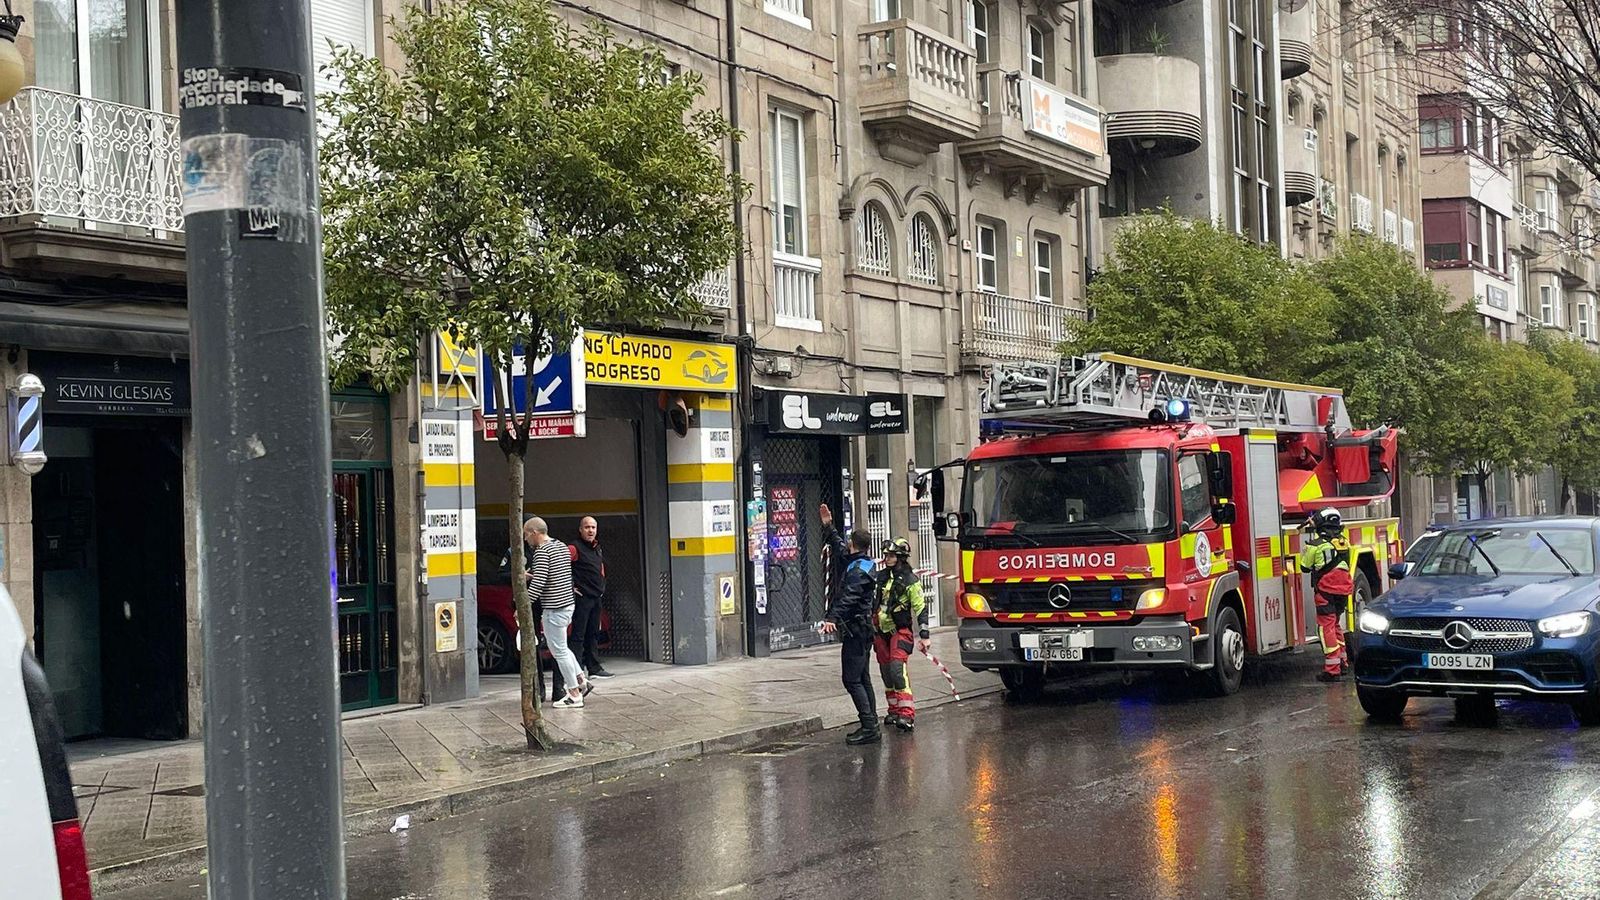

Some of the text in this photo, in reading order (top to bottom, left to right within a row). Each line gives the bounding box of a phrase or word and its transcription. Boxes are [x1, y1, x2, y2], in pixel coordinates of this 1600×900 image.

[611, 339, 672, 360] LAVADO
[585, 361, 660, 381] ROGRESO
[60, 384, 172, 400] KEVIN IGLESIAS
[782, 394, 860, 430] EL underwear
[870, 401, 902, 417] EL
[539, 419, 547, 428] LA
[548, 417, 574, 427] MAÑANA
[870, 421, 902, 429] underwear
[428, 514, 457, 527] LIMPIEZA DE
[1059, 649, 1079, 660] GBC
[1431, 655, 1491, 668] 0095 LZN
